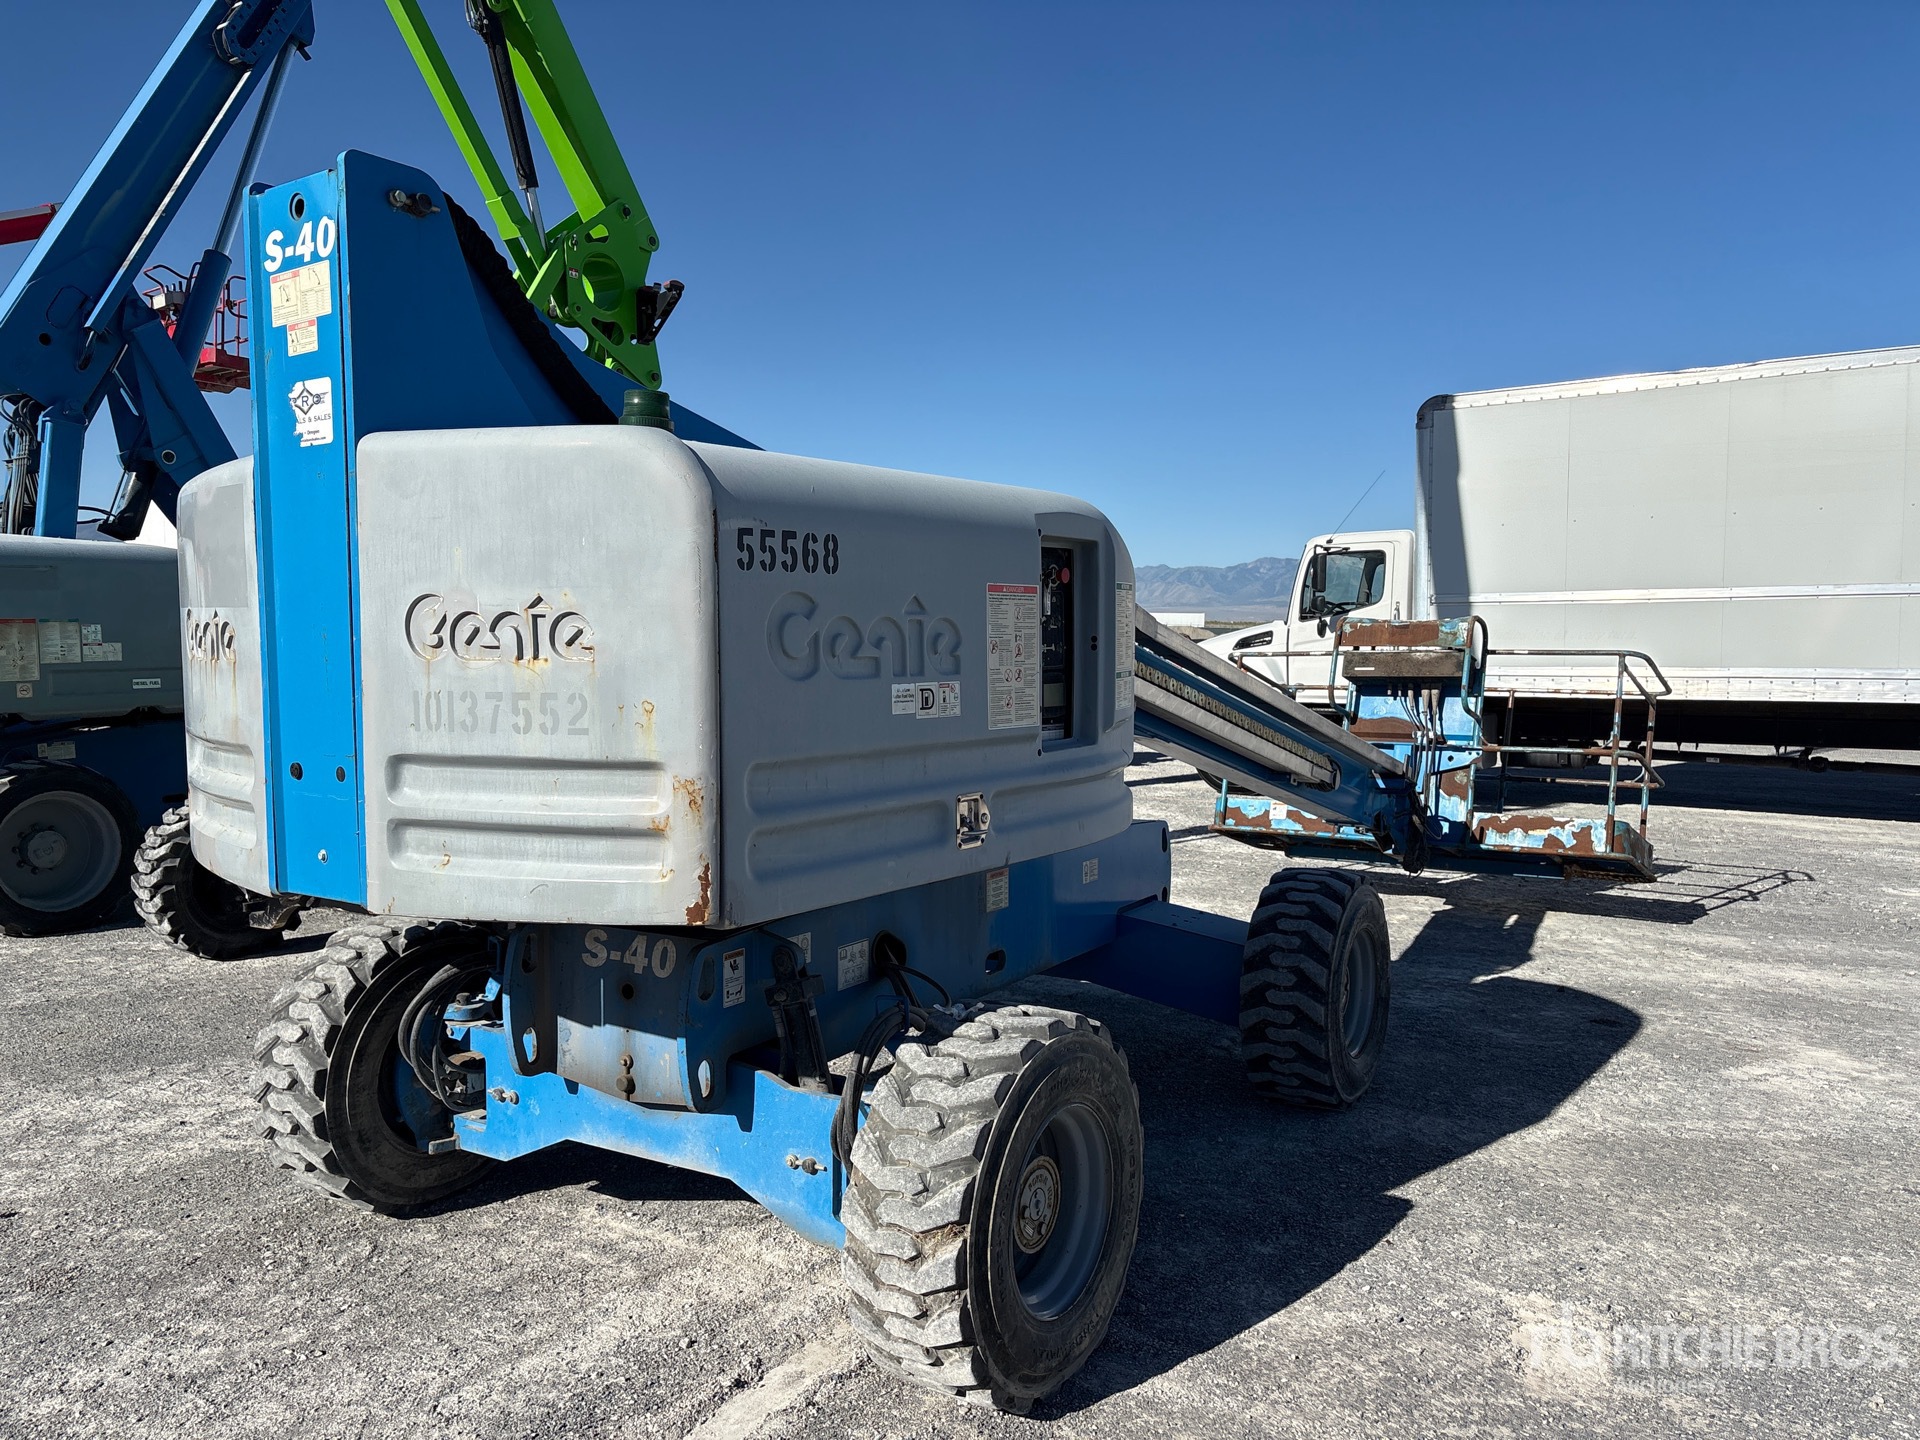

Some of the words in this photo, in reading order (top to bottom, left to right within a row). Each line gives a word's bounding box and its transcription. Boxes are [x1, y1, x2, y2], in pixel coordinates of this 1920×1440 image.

[264, 215, 335, 273] S-40
[313, 413, 332, 422] SALES
[736, 527, 839, 575] 55568
[404, 593, 595, 662] Genie
[764, 590, 963, 682] Genie
[411, 689, 591, 737] 10137552
[581, 928, 678, 979] S-40
